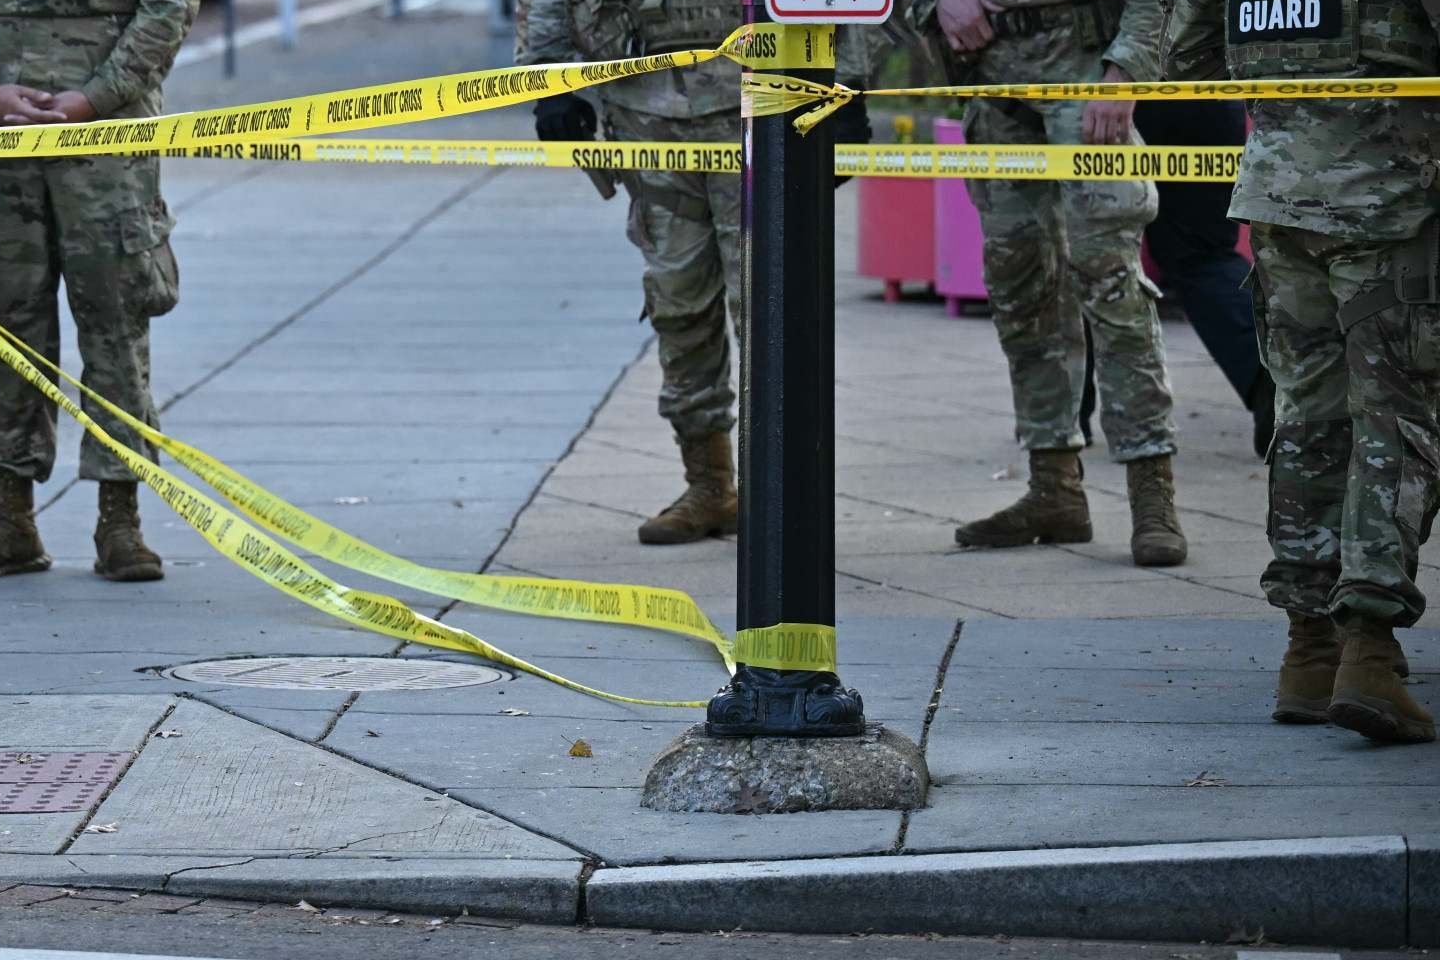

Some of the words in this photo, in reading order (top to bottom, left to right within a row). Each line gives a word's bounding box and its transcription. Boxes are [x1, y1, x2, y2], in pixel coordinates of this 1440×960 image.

[745, 33, 776, 58] CROSS
[580, 65, 607, 82] POLICE
[606, 62, 625, 78] LINE
[622, 59, 634, 74] DO
[634, 57, 654, 73] NOT
[649, 54, 676, 70] CROSS
[456, 78, 483, 104] POLICE
[480, 74, 500, 99] LINE
[498, 73, 510, 95] DO
[509, 71, 527, 94] NOT
[524, 69, 549, 91] CROSS
[327, 100, 354, 123] POLICE
[354, 98, 371, 121] LINE
[371, 96, 382, 117] DO
[383, 93, 399, 116] NOT
[398, 88, 423, 113] CROSS
[55, 128, 87, 149] POLICE
[83, 127, 106, 147] LINE
[101, 126, 114, 146] DO
[112, 124, 134, 145] NOT
[131, 121, 159, 143] CROSS
[192, 116, 222, 138] POLICE
[219, 113, 239, 136] LINE
[237, 112, 249, 134] DO
[248, 110, 268, 133] NOT
[265, 107, 292, 130] CROSS
[192, 143, 244, 160] SCENE
[250, 143, 301, 160] CRIME
[572, 147, 625, 169] CROSS
[628, 148, 660, 170] NOT
[665, 149, 688, 170] DO
[692, 149, 742, 171] SCENE
[873, 150, 905, 173] NOT
[910, 150, 933, 173] DO
[937, 150, 990, 174] SCENE
[994, 150, 1047, 175] CRIME
[1072, 151, 1127, 177] CROSS
[1129, 151, 1161, 177] NOT
[1167, 152, 1188, 177] DO
[151, 472, 166, 495] DO
[179, 492, 218, 533] POLICE
